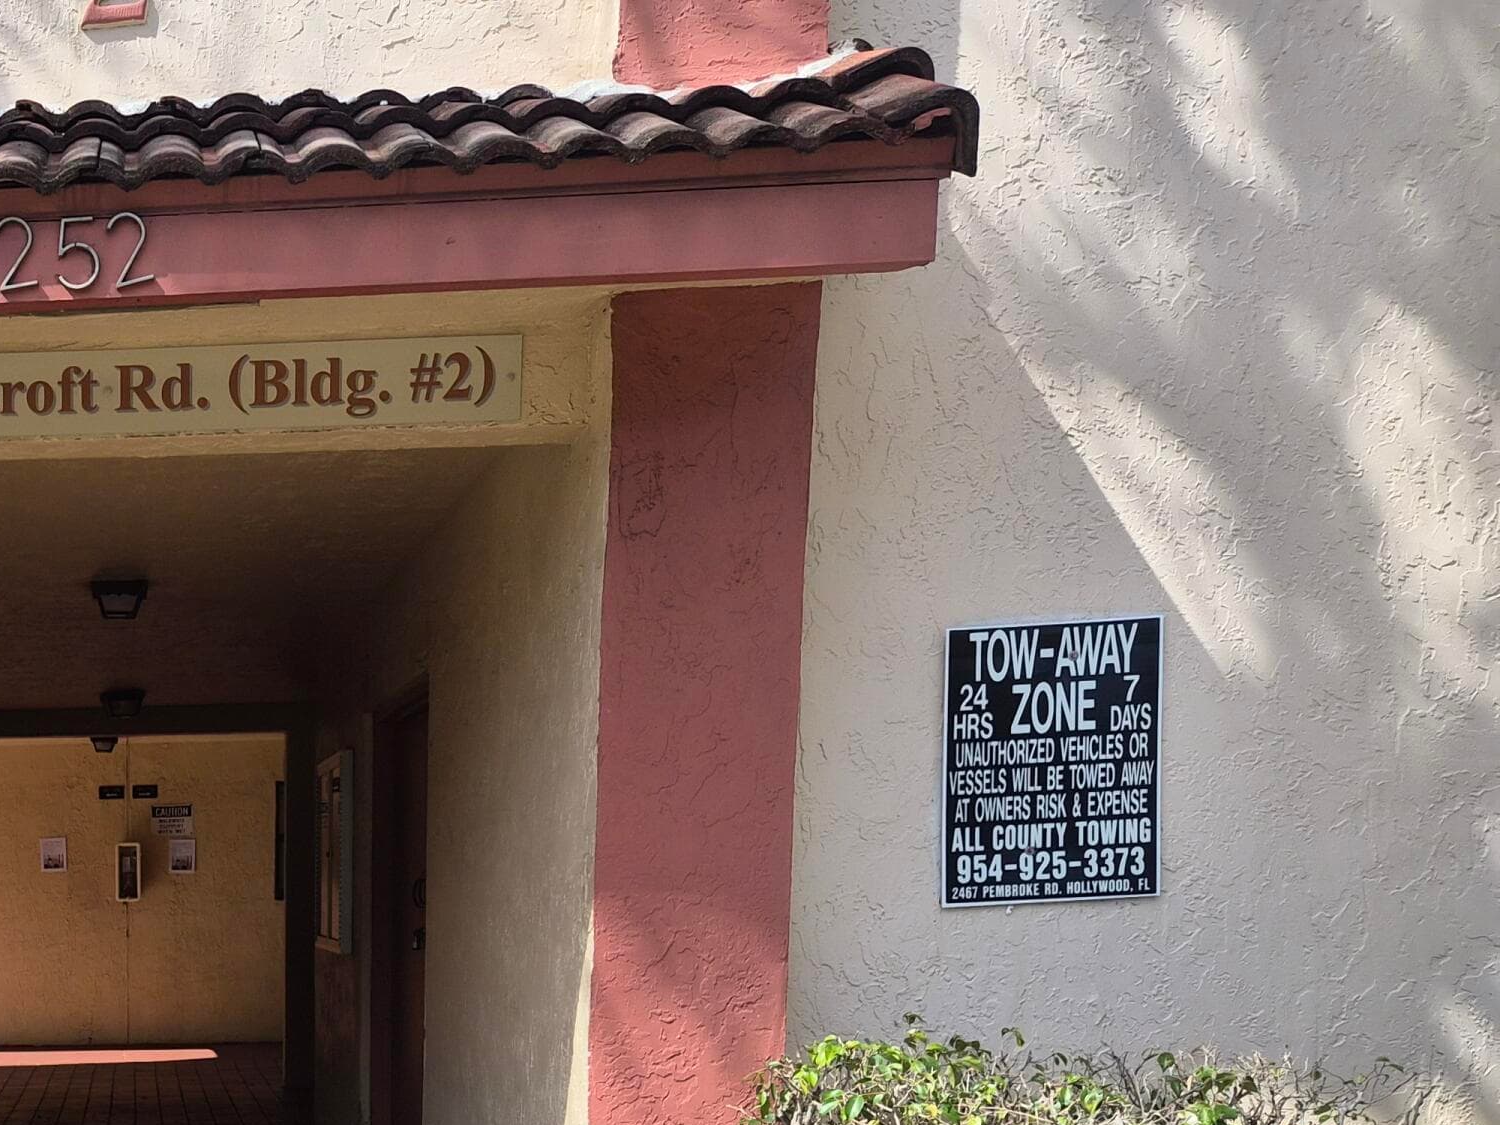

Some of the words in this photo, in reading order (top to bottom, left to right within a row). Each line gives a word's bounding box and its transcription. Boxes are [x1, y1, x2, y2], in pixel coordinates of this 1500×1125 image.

[113, 363, 209, 414] Rd.
[227, 353, 392, 417] (Bldg.
[409, 345, 496, 406] #2)
[969, 623, 1138, 682] TOW-AWAY
[960, 684, 989, 712] 24
[1124, 675, 1140, 701] 7
[1010, 680, 1096, 735] ZONE
[1110, 704, 1152, 732] DAYS
[953, 712, 993, 740] HRS
[956, 738, 1054, 767] UNAUTHORIZED
[1060, 734, 1124, 762] VEHICLES
[1129, 733, 1148, 757] OR
[950, 768, 1006, 796] VESSELS
[1012, 766, 1042, 792] WILL
[1047, 766, 1064, 790] BE
[1070, 763, 1116, 790] TOWED
[1121, 760, 1154, 786] AWAY
[155, 807, 189, 816] CAUTION
[954, 798, 970, 822] AT
[974, 796, 1031, 822] OWNERS
[1036, 794, 1067, 818] RISK
[1072, 794, 1082, 817] &
[1088, 790, 1148, 816] EXPENSE
[952, 828, 984, 852] ALL
[992, 822, 1067, 851] COUNTY
[1076, 818, 1152, 846] TOWING
[956, 846, 1146, 884] 954-925-3373
[952, 886, 978, 900] 2467
[982, 883, 1040, 898] PEMBROKE
[1044, 882, 1062, 894] RD.
[1066, 878, 1134, 894] HOLLYWOOD,
[1138, 878, 1150, 891] FL
